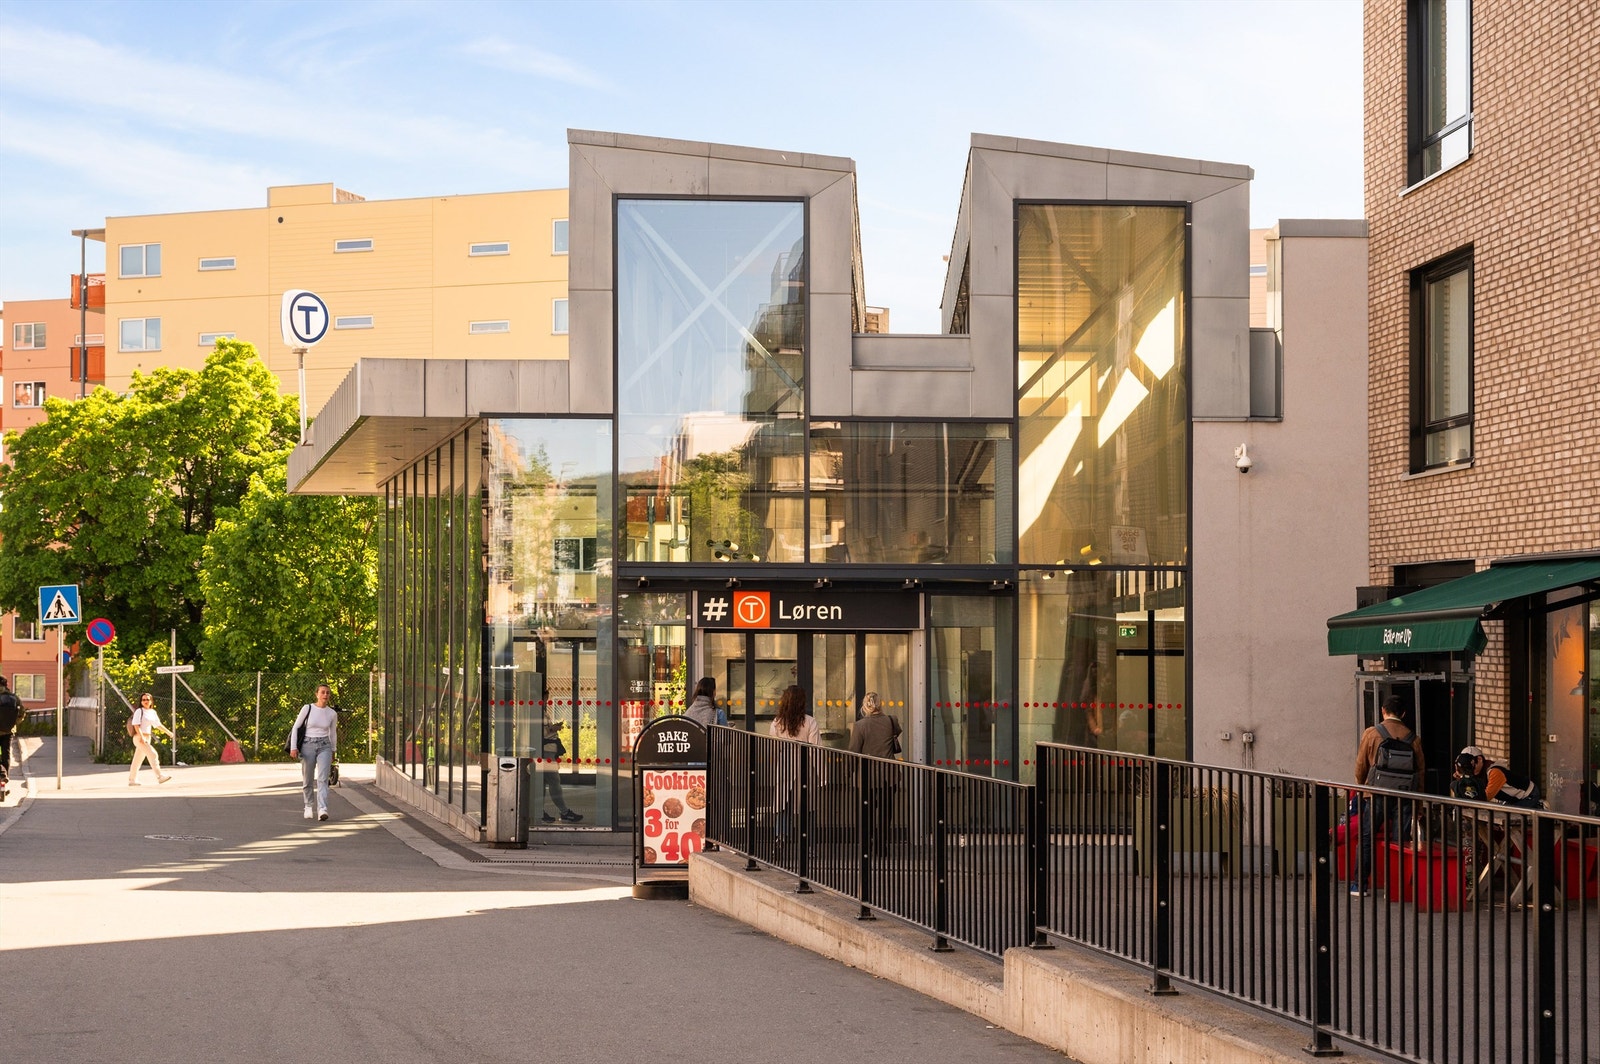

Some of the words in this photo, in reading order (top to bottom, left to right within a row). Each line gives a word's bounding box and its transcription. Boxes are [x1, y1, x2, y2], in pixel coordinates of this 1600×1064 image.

[297, 305, 318, 335] T
[779, 600, 842, 620] Løren
[658, 731, 689, 742] BAKE
[657, 743, 674, 753] ME
[676, 743, 691, 753] UP
[645, 771, 706, 791] Cookies
[645, 808, 663, 838] 3
[665, 819, 679, 830] for
